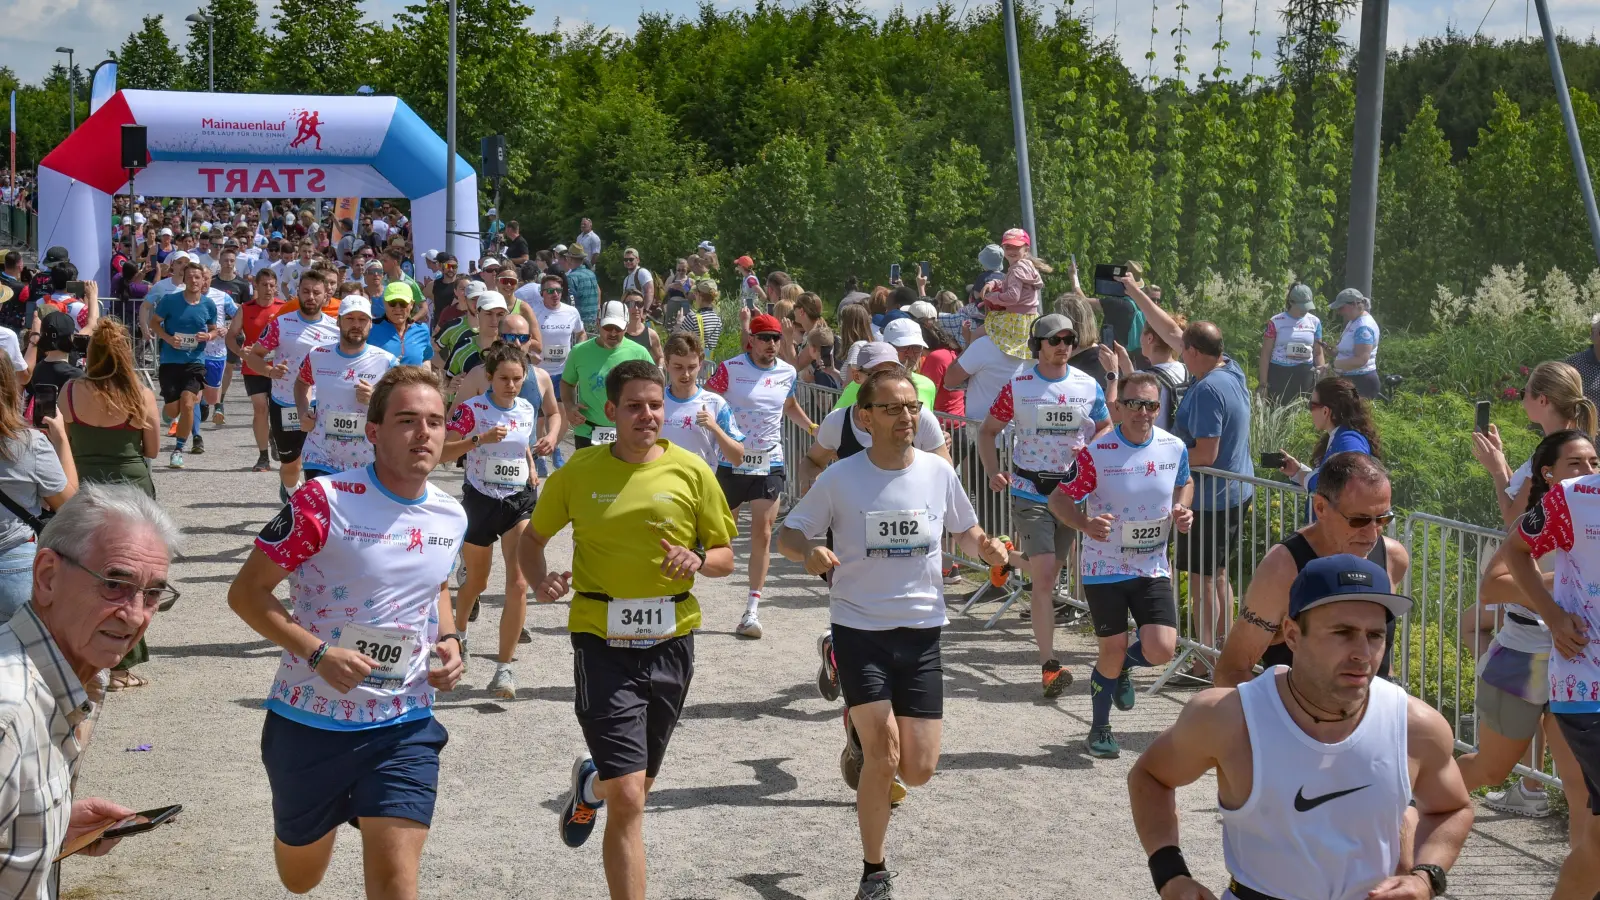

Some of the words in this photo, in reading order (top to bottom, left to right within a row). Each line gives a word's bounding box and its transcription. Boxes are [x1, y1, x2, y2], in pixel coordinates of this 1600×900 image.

[202, 118, 286, 131] Mainauenlauf
[1015, 374, 1034, 382] NKD
[287, 412, 298, 421] 33
[1045, 411, 1073, 422] 3165
[333, 418, 358, 429] 3091
[1096, 442, 1119, 450] NKD
[494, 464, 520, 477] 3095
[331, 481, 367, 494] NKD
[343, 528, 392, 540] Mainauenlauf
[879, 520, 919, 536] 3162
[1132, 526, 1161, 540] 3223
[438, 536, 454, 549] cep
[621, 608, 662, 626] 3411
[355, 639, 402, 664] 3309
